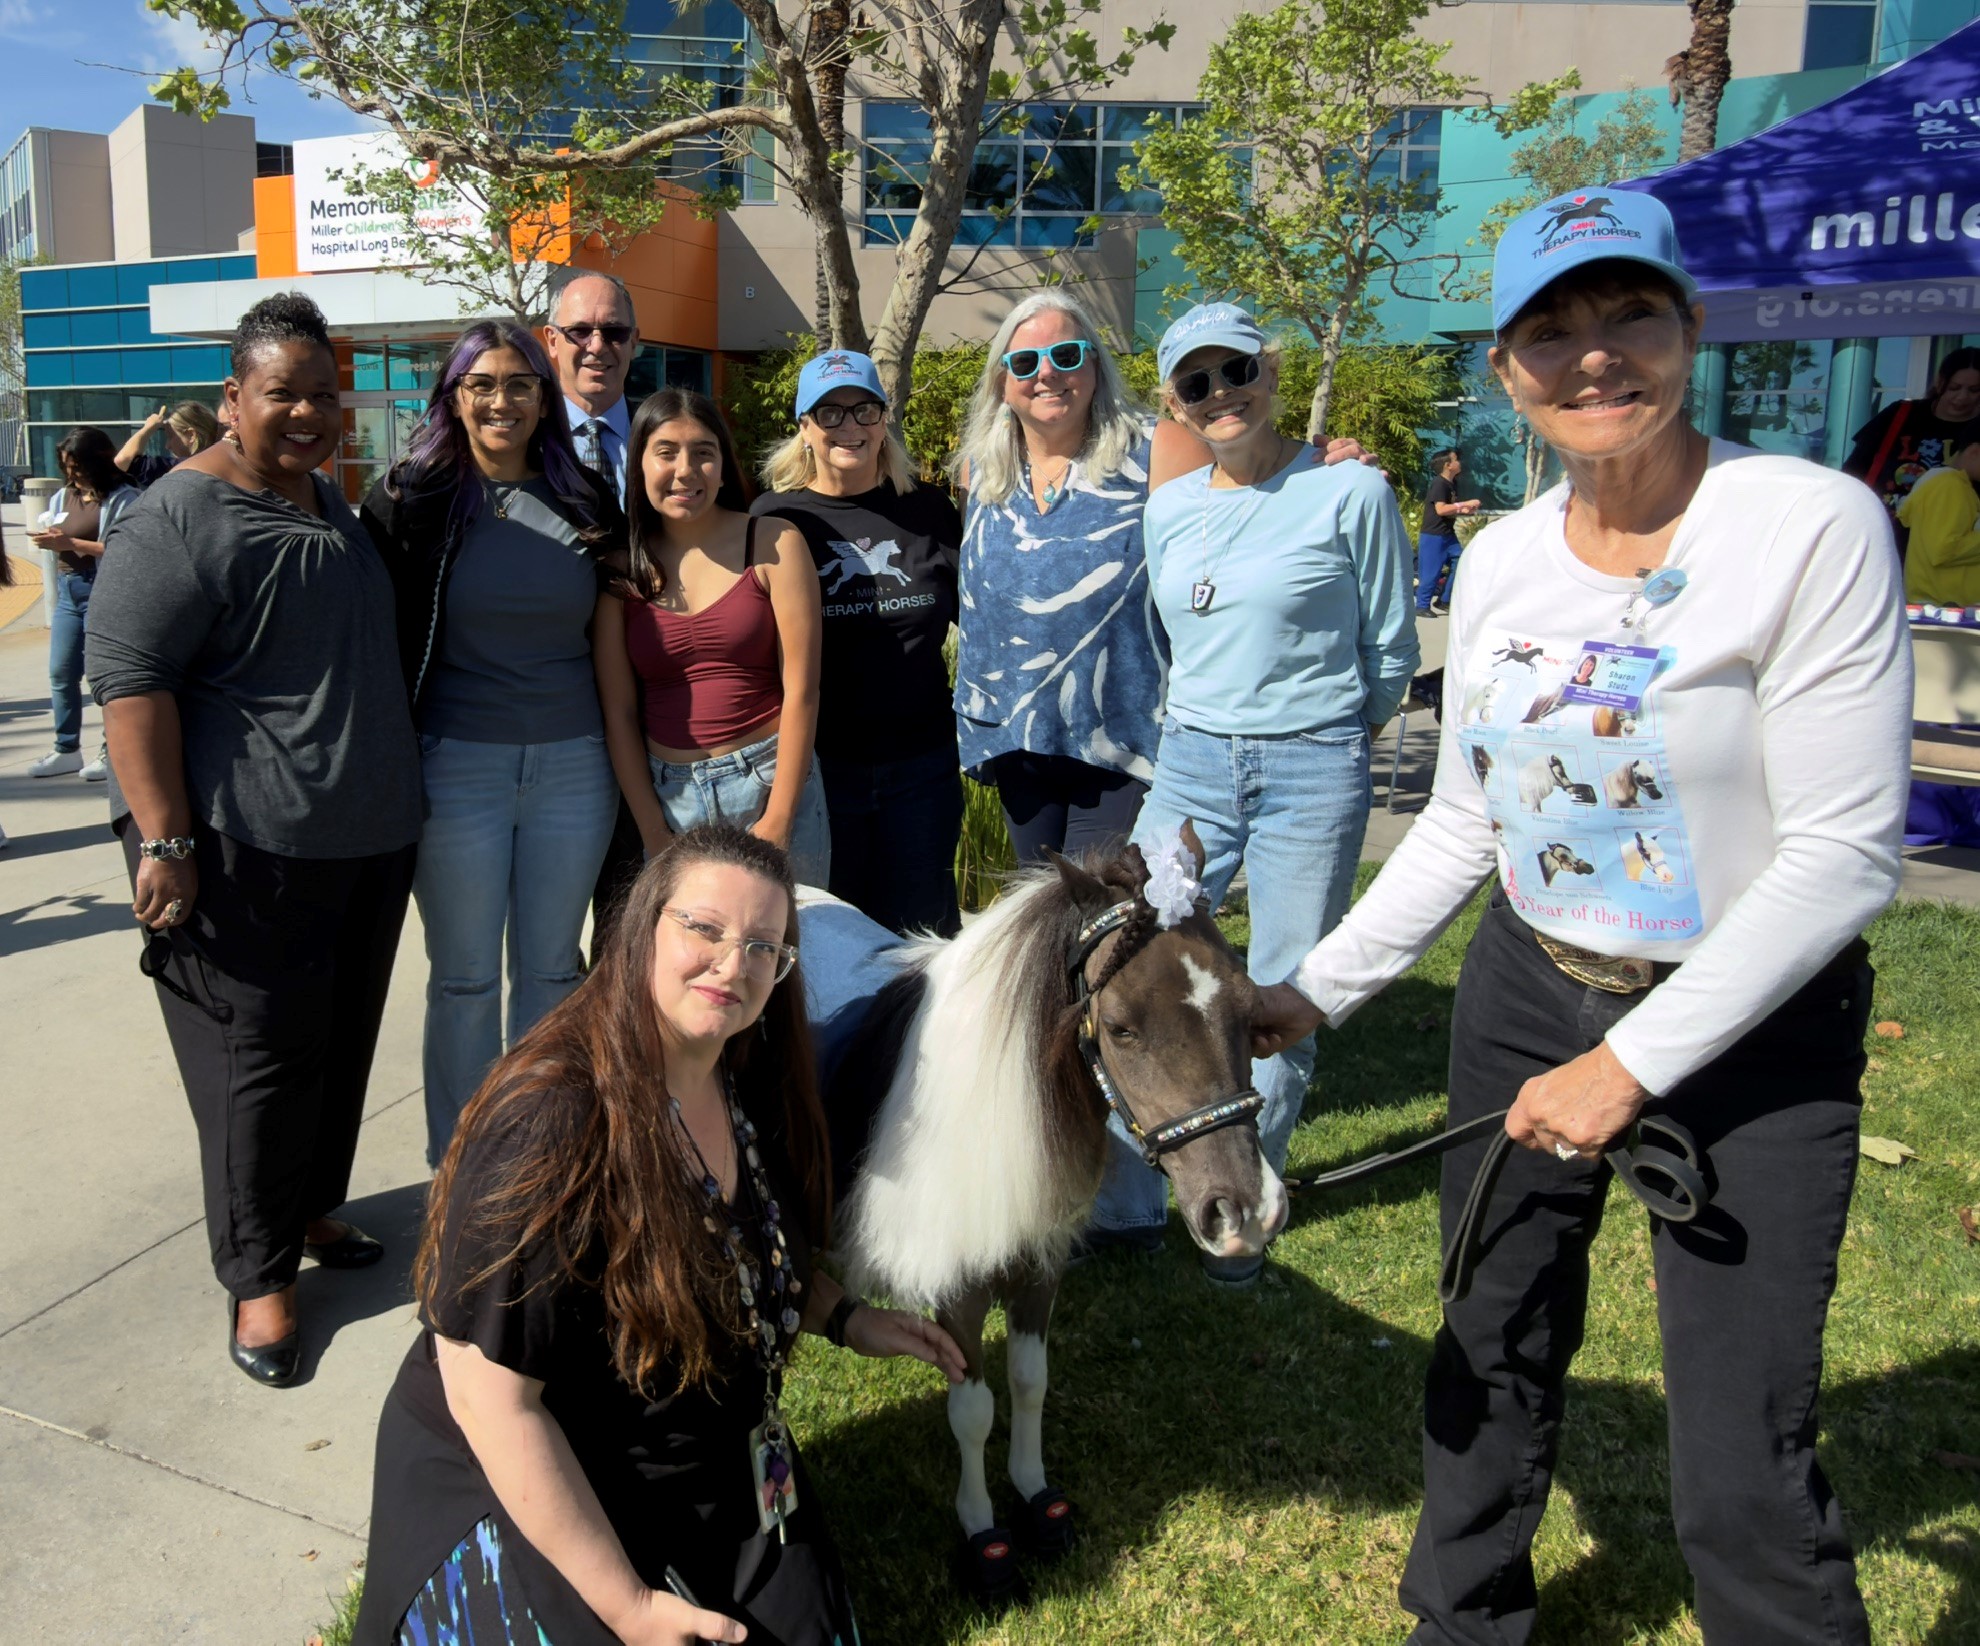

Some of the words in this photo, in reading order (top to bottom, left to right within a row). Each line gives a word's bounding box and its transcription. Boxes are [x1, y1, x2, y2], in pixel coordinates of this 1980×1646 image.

[311, 224, 342, 236] Miller
[312, 239, 359, 257] Hospital
[361, 239, 388, 254] Long
[1532, 229, 1588, 259] THERAPY
[1591, 227, 1642, 240] HORSES
[745, 286, 755, 298] B
[856, 586, 884, 598] MINI
[821, 602, 874, 617] HERAPY
[877, 593, 936, 612] HORSES
[1608, 670, 1636, 681] Sharon
[1607, 680, 1629, 691] Stutz
[1640, 883, 1656, 894] Blue
[1657, 886, 1674, 896] Lily
[1525, 896, 1564, 919] Year
[1571, 903, 1589, 921] of
[1594, 907, 1621, 926] the
[1627, 910, 1694, 931] Horse
